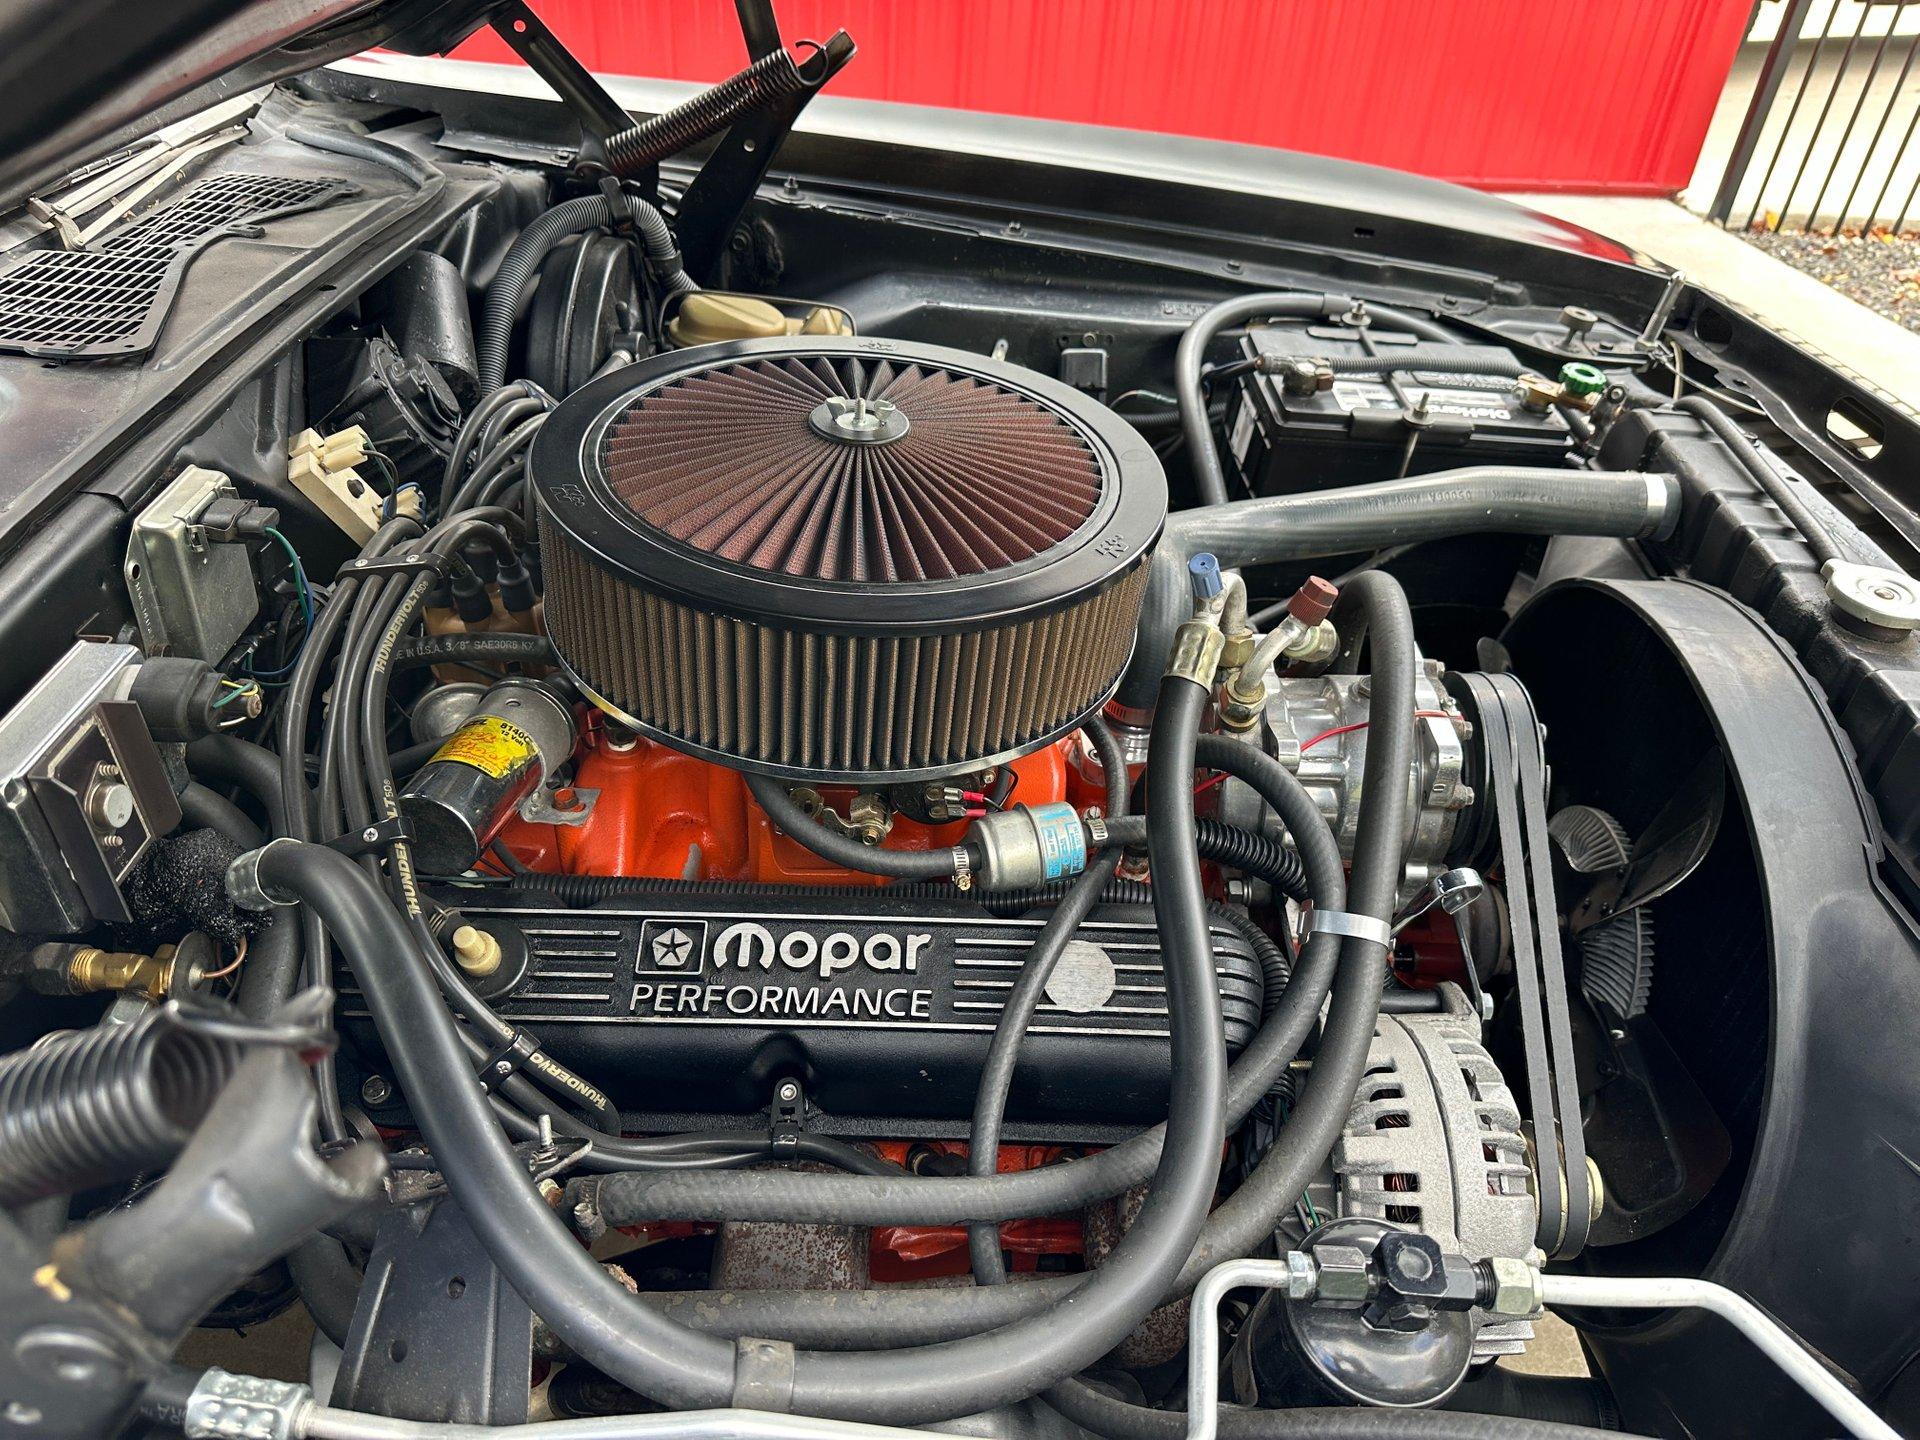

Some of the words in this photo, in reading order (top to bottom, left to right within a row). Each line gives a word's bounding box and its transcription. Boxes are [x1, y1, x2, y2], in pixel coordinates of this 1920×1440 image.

[375, 590, 419, 674] THUNDERVOLT
[713, 922, 932, 977] Mopar
[629, 984, 933, 1017] PERFORMANCE
